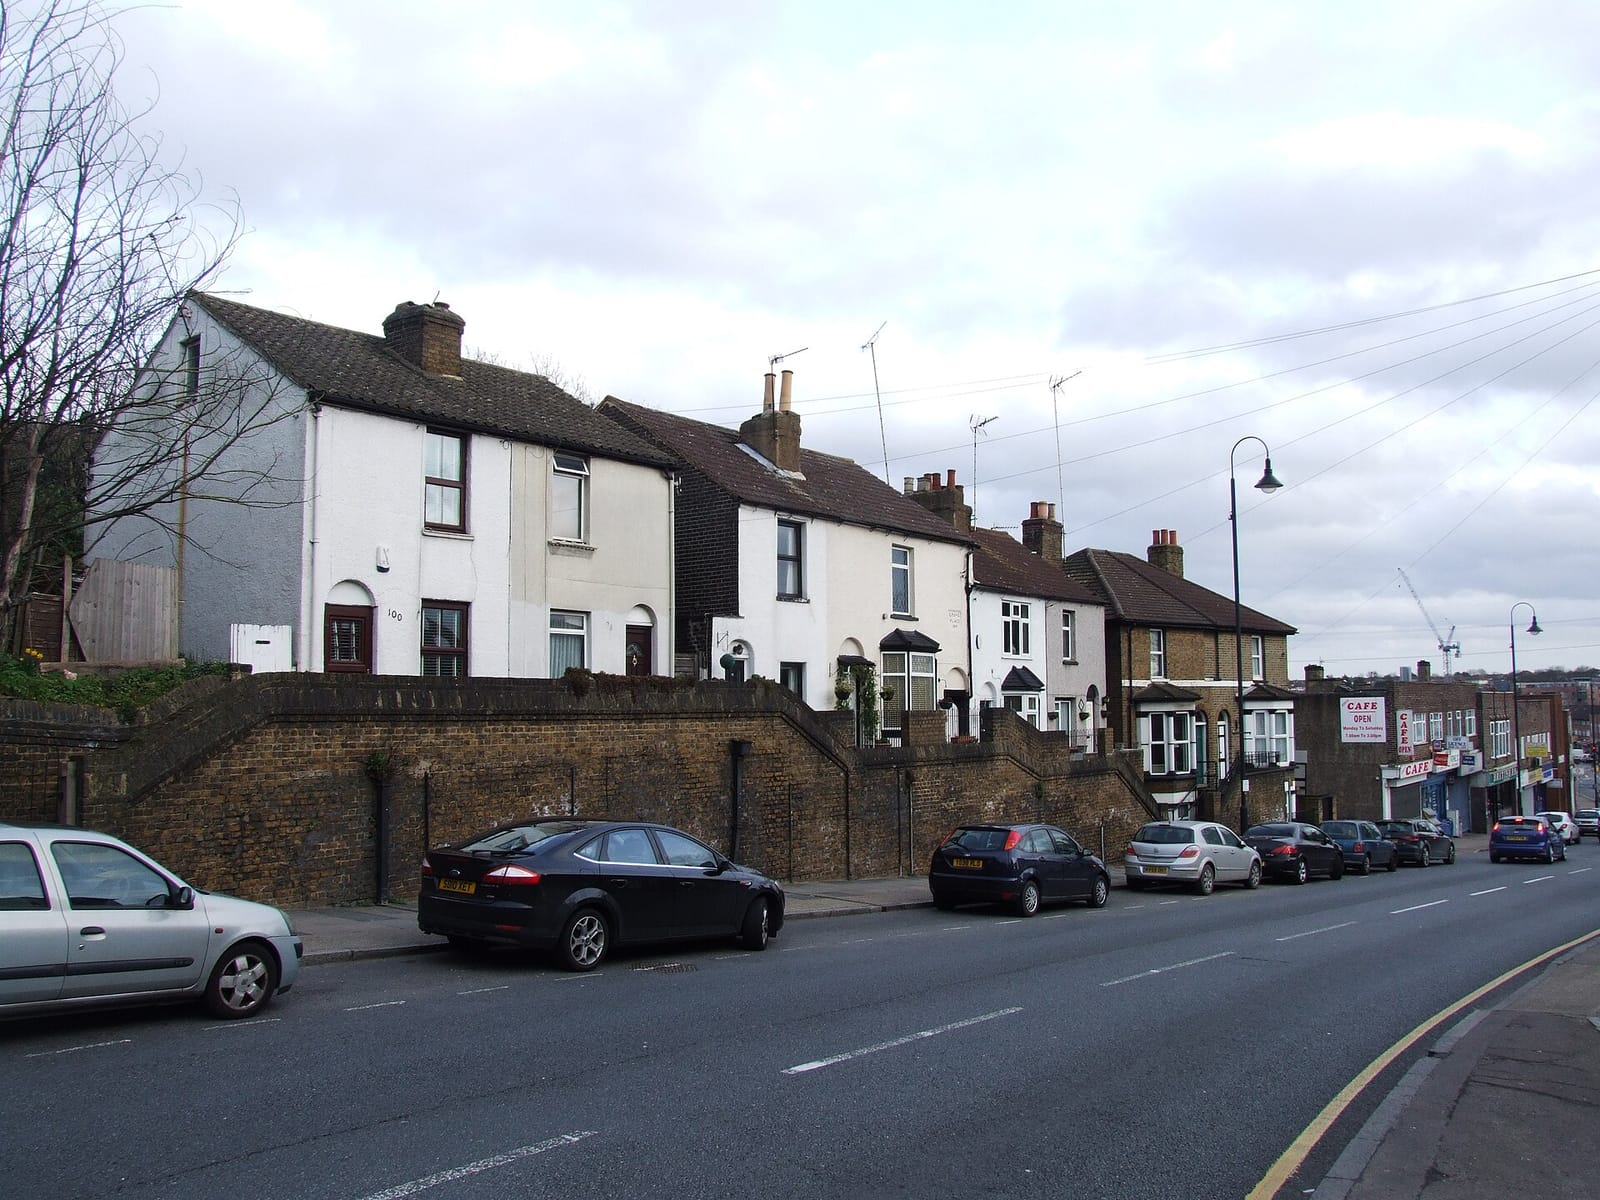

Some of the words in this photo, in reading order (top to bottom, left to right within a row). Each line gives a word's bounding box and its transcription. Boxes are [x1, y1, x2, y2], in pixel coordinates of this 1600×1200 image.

[388, 608, 402, 621] 100
[1347, 702, 1377, 710] CAFE
[1353, 714, 1372, 723] OPEN
[1400, 713, 1408, 744] CAFE
[1405, 762, 1429, 775] CAFE
